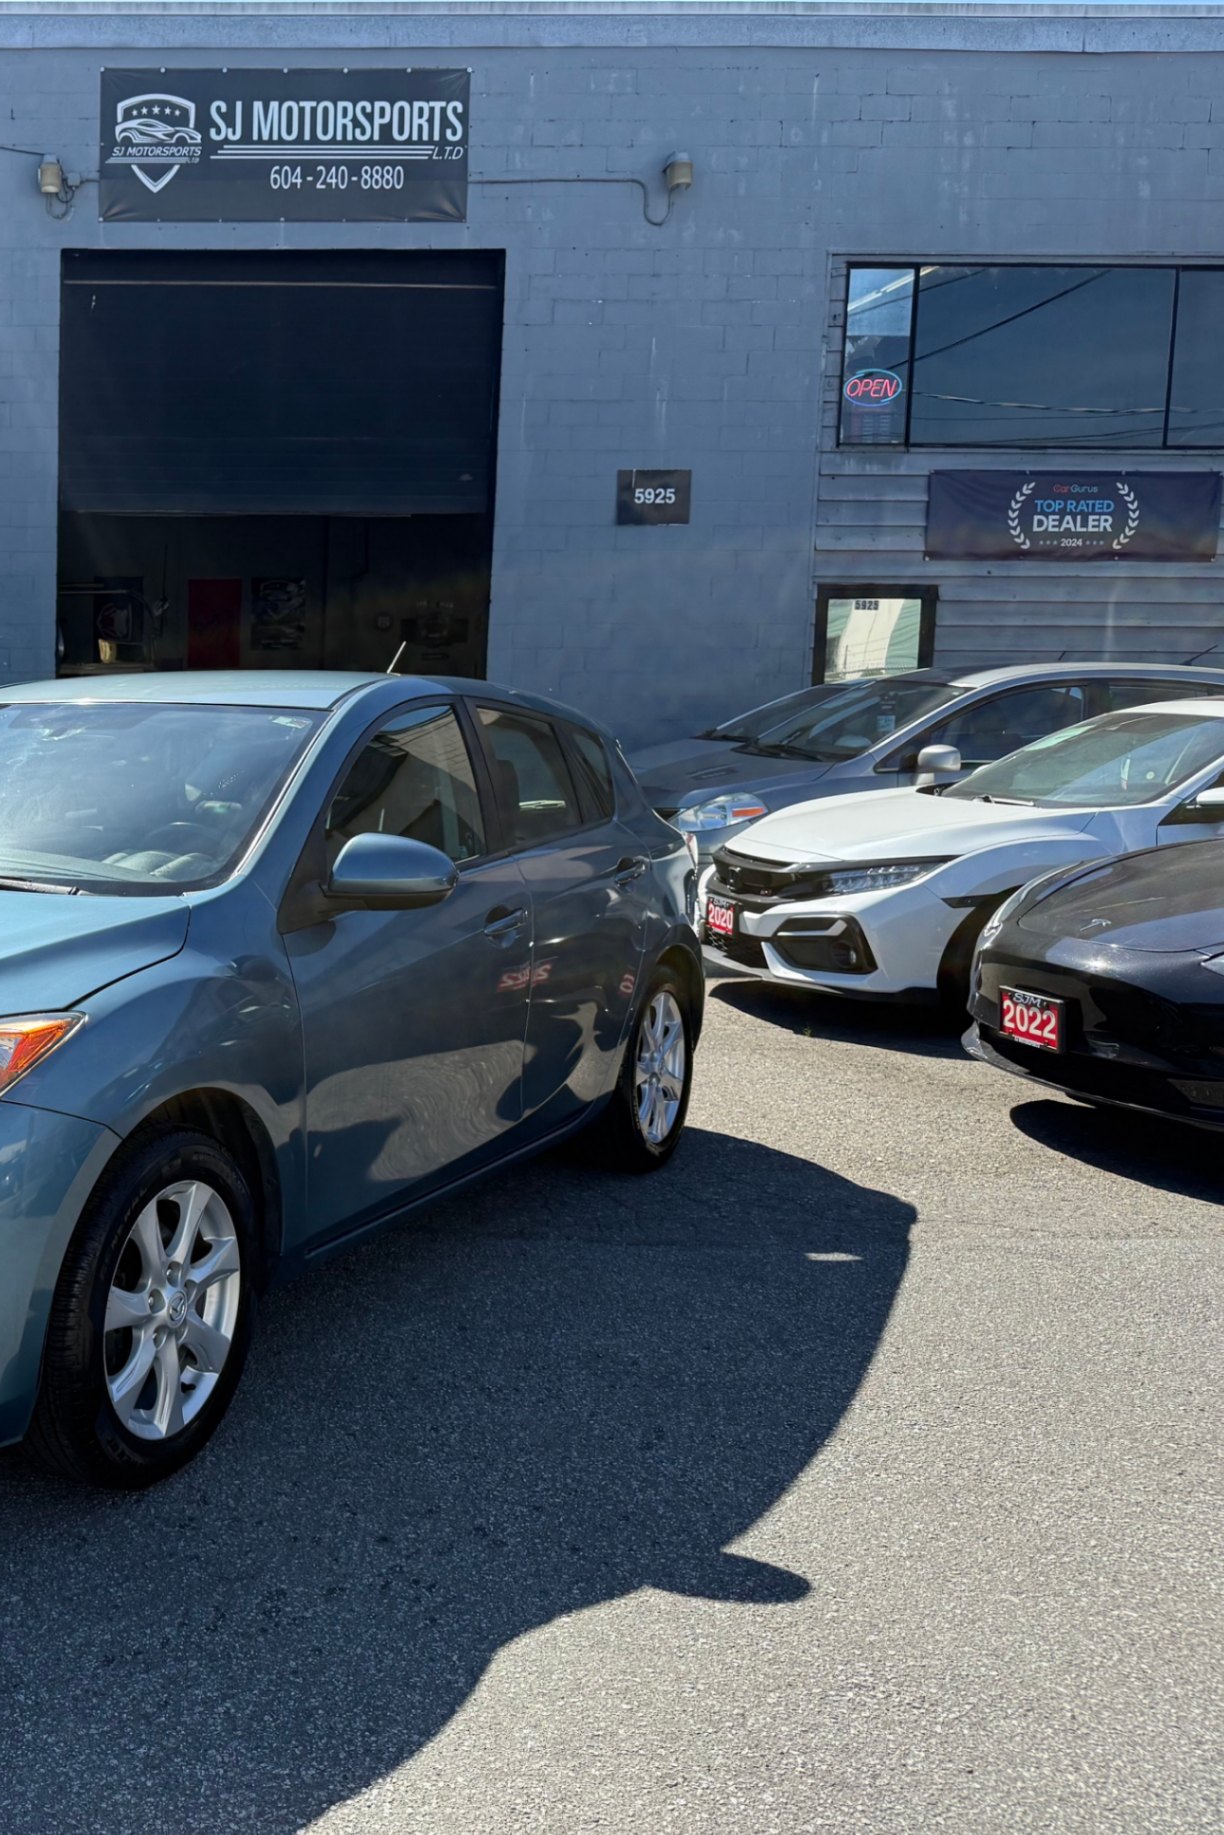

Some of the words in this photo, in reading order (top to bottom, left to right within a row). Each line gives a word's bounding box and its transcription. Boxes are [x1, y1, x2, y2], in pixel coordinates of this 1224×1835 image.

[209, 101, 242, 141] SJ
[252, 101, 464, 142] MOTORSPORTS
[112, 146, 125, 156] SJ
[126, 146, 202, 156] MOTORSPORTS
[846, 379, 897, 397] OPEN
[634, 488, 676, 504] 5925
[1053, 484, 1098, 493] CarGurus
[1035, 500, 1064, 512] TOP
[1067, 500, 1114, 512] RATED
[1033, 515, 1112, 532] DEALER
[1060, 539, 1083, 547] 2024
[708, 903, 733, 930] 2020
[1013, 992, 1042, 1008] SJM
[1003, 1000, 1056, 1040] 2022
